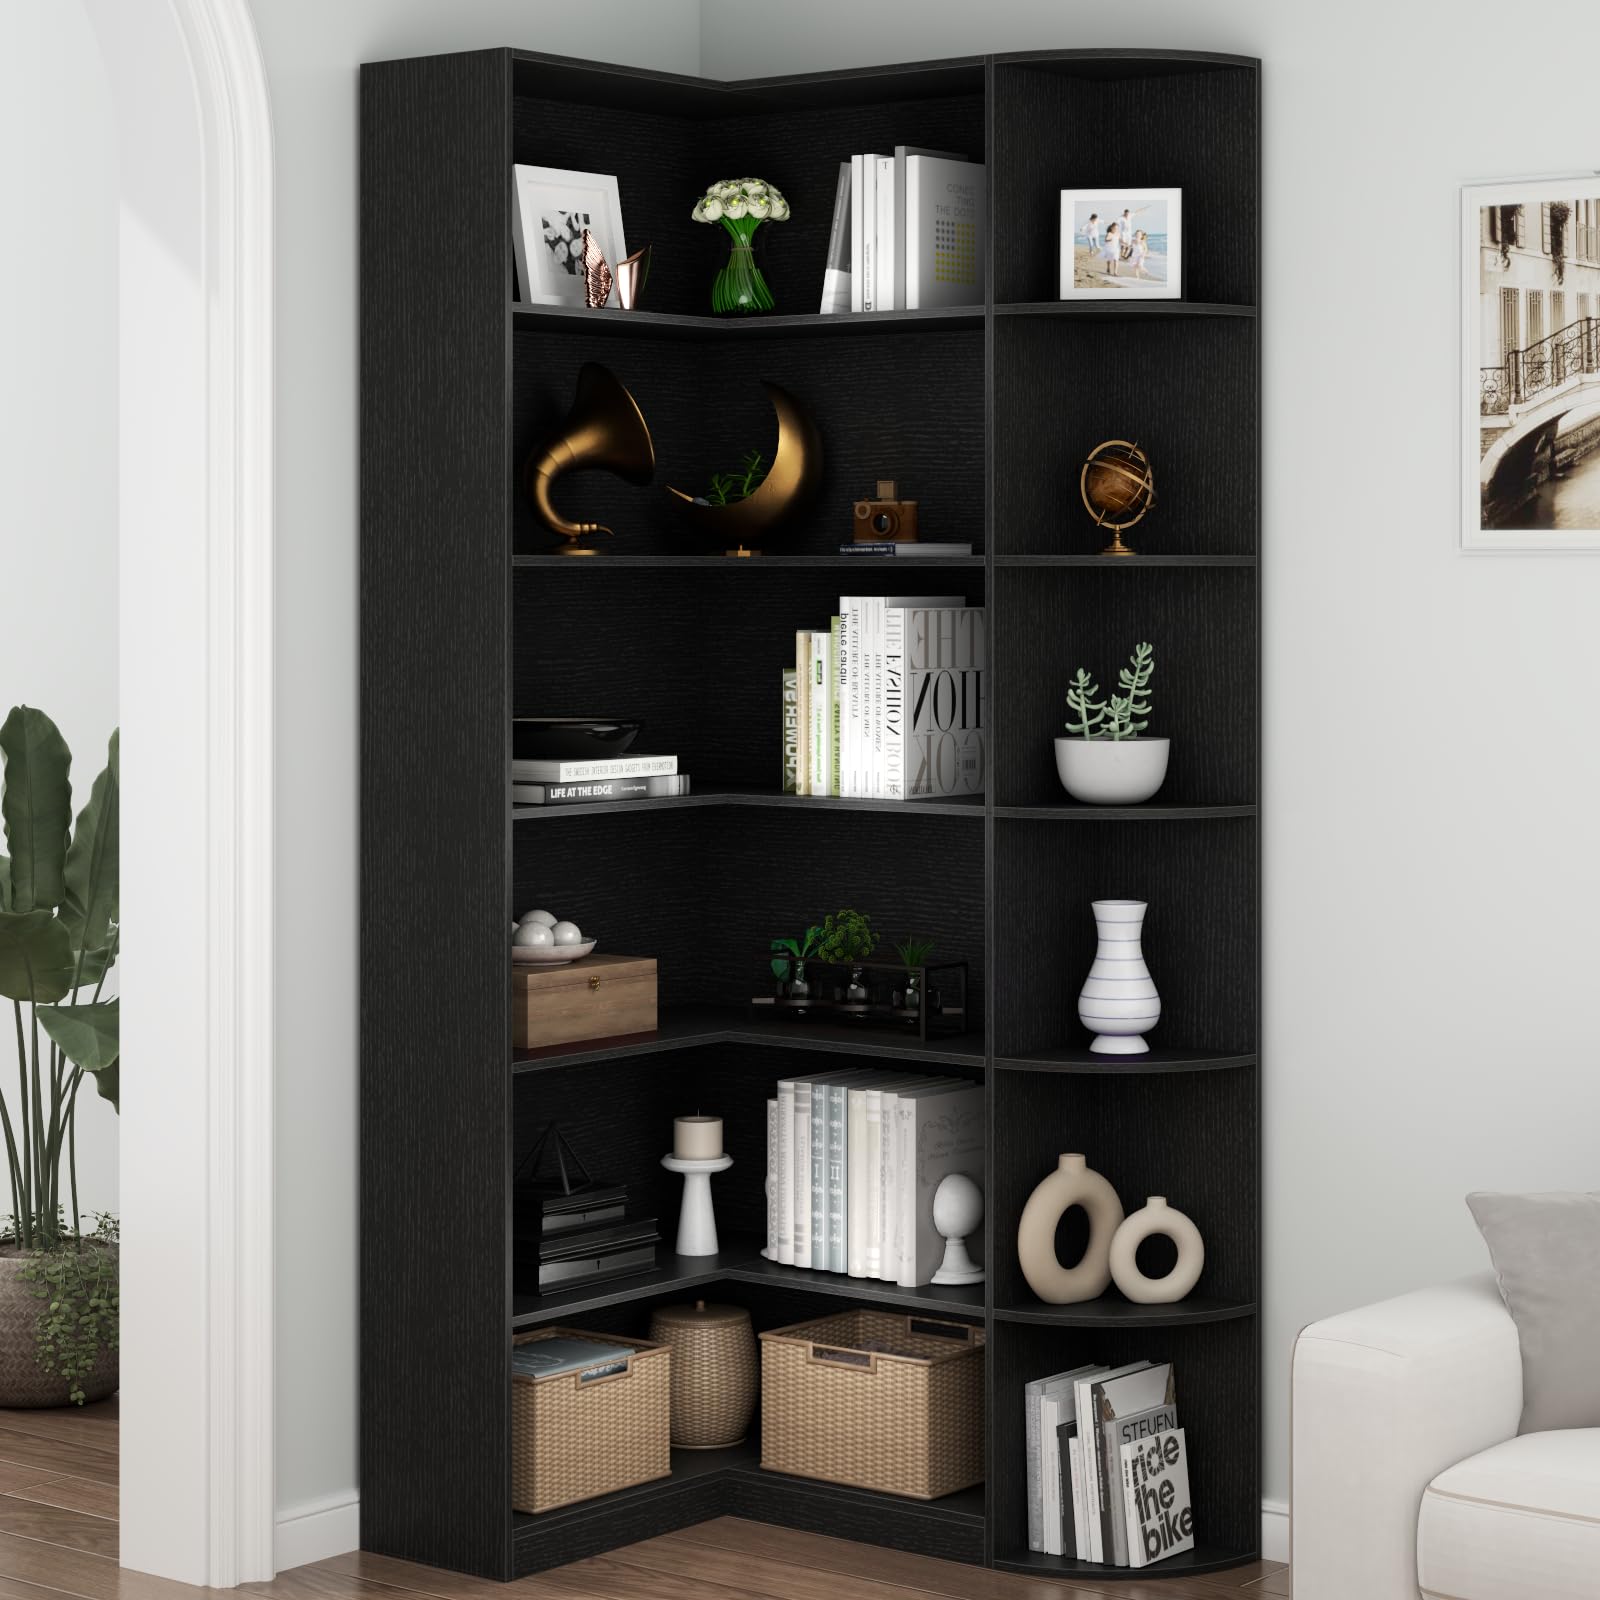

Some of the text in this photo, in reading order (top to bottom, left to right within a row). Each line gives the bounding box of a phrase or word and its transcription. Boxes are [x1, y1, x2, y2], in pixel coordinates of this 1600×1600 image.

[550, 788, 566, 798] LIFE
[567, 787, 576, 797] AT
[577, 786, 592, 796] THE
[593, 785, 612, 795] EDGE
[1131, 1436, 1180, 1488] ride
[1134, 1479, 1175, 1524] the
[1142, 1506, 1193, 1562] bike
